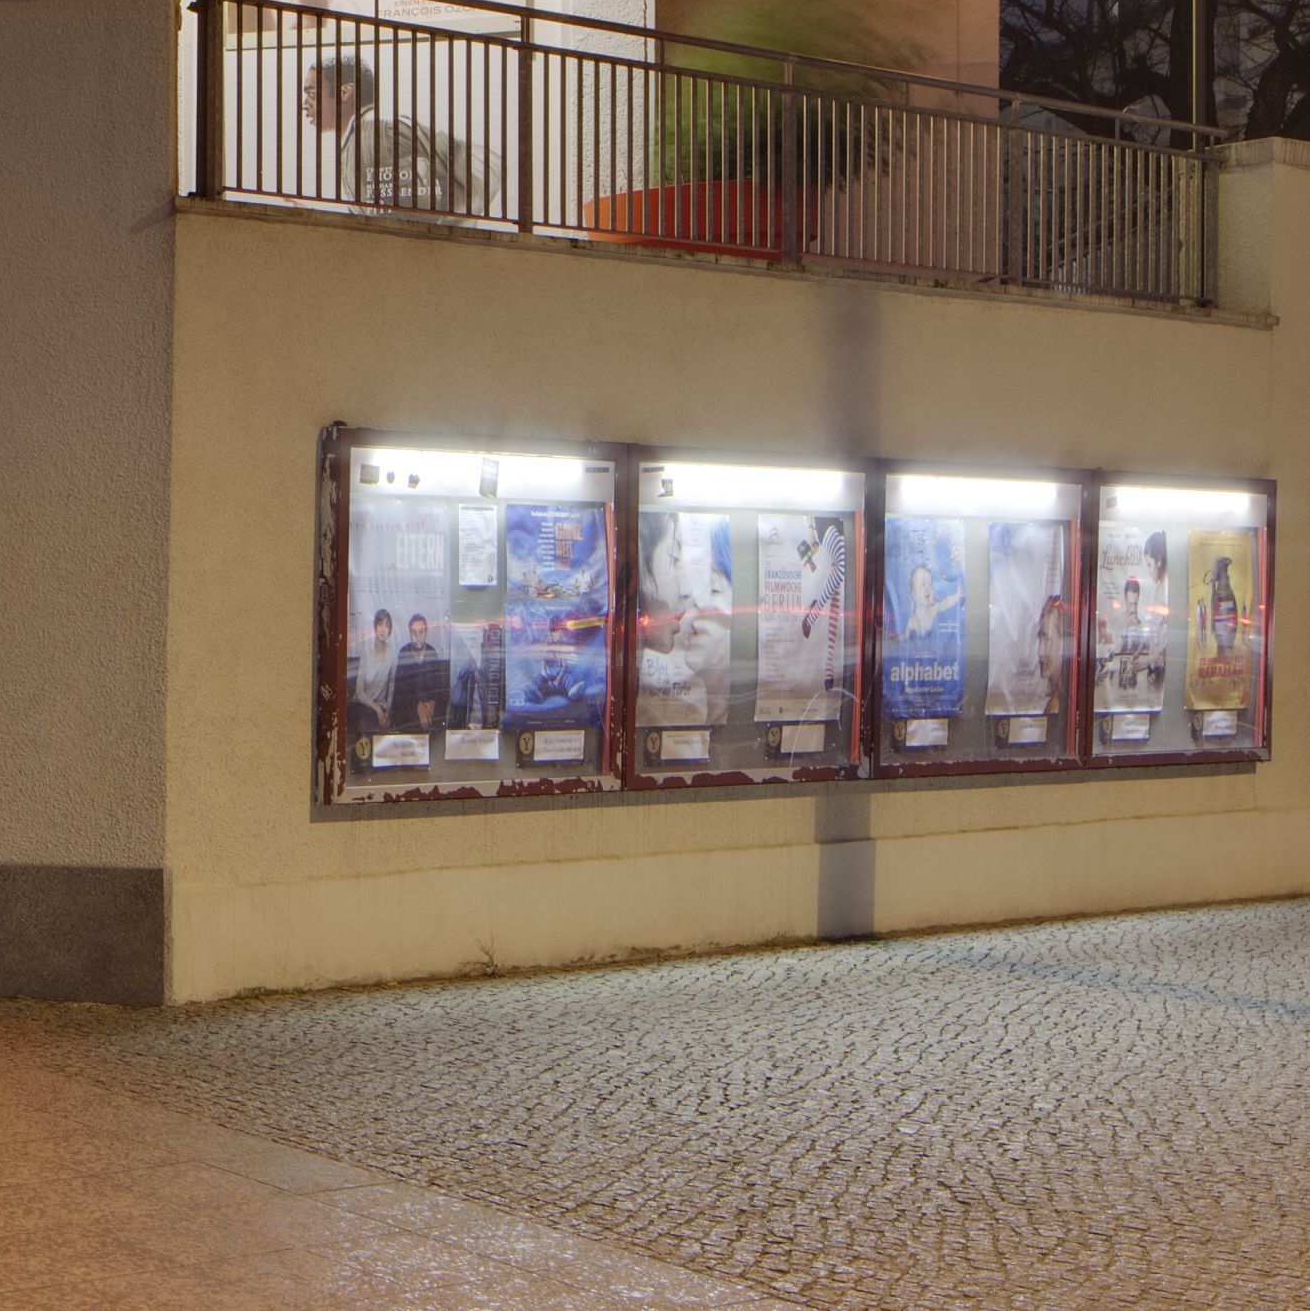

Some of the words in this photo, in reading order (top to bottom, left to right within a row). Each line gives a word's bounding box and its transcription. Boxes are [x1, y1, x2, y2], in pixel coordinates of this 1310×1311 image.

[396, 533, 444, 569] ELTERN
[764, 581, 802, 593] FILMWOCHE
[764, 593, 802, 611] BERLIN
[890, 662, 959, 686] alphabet
